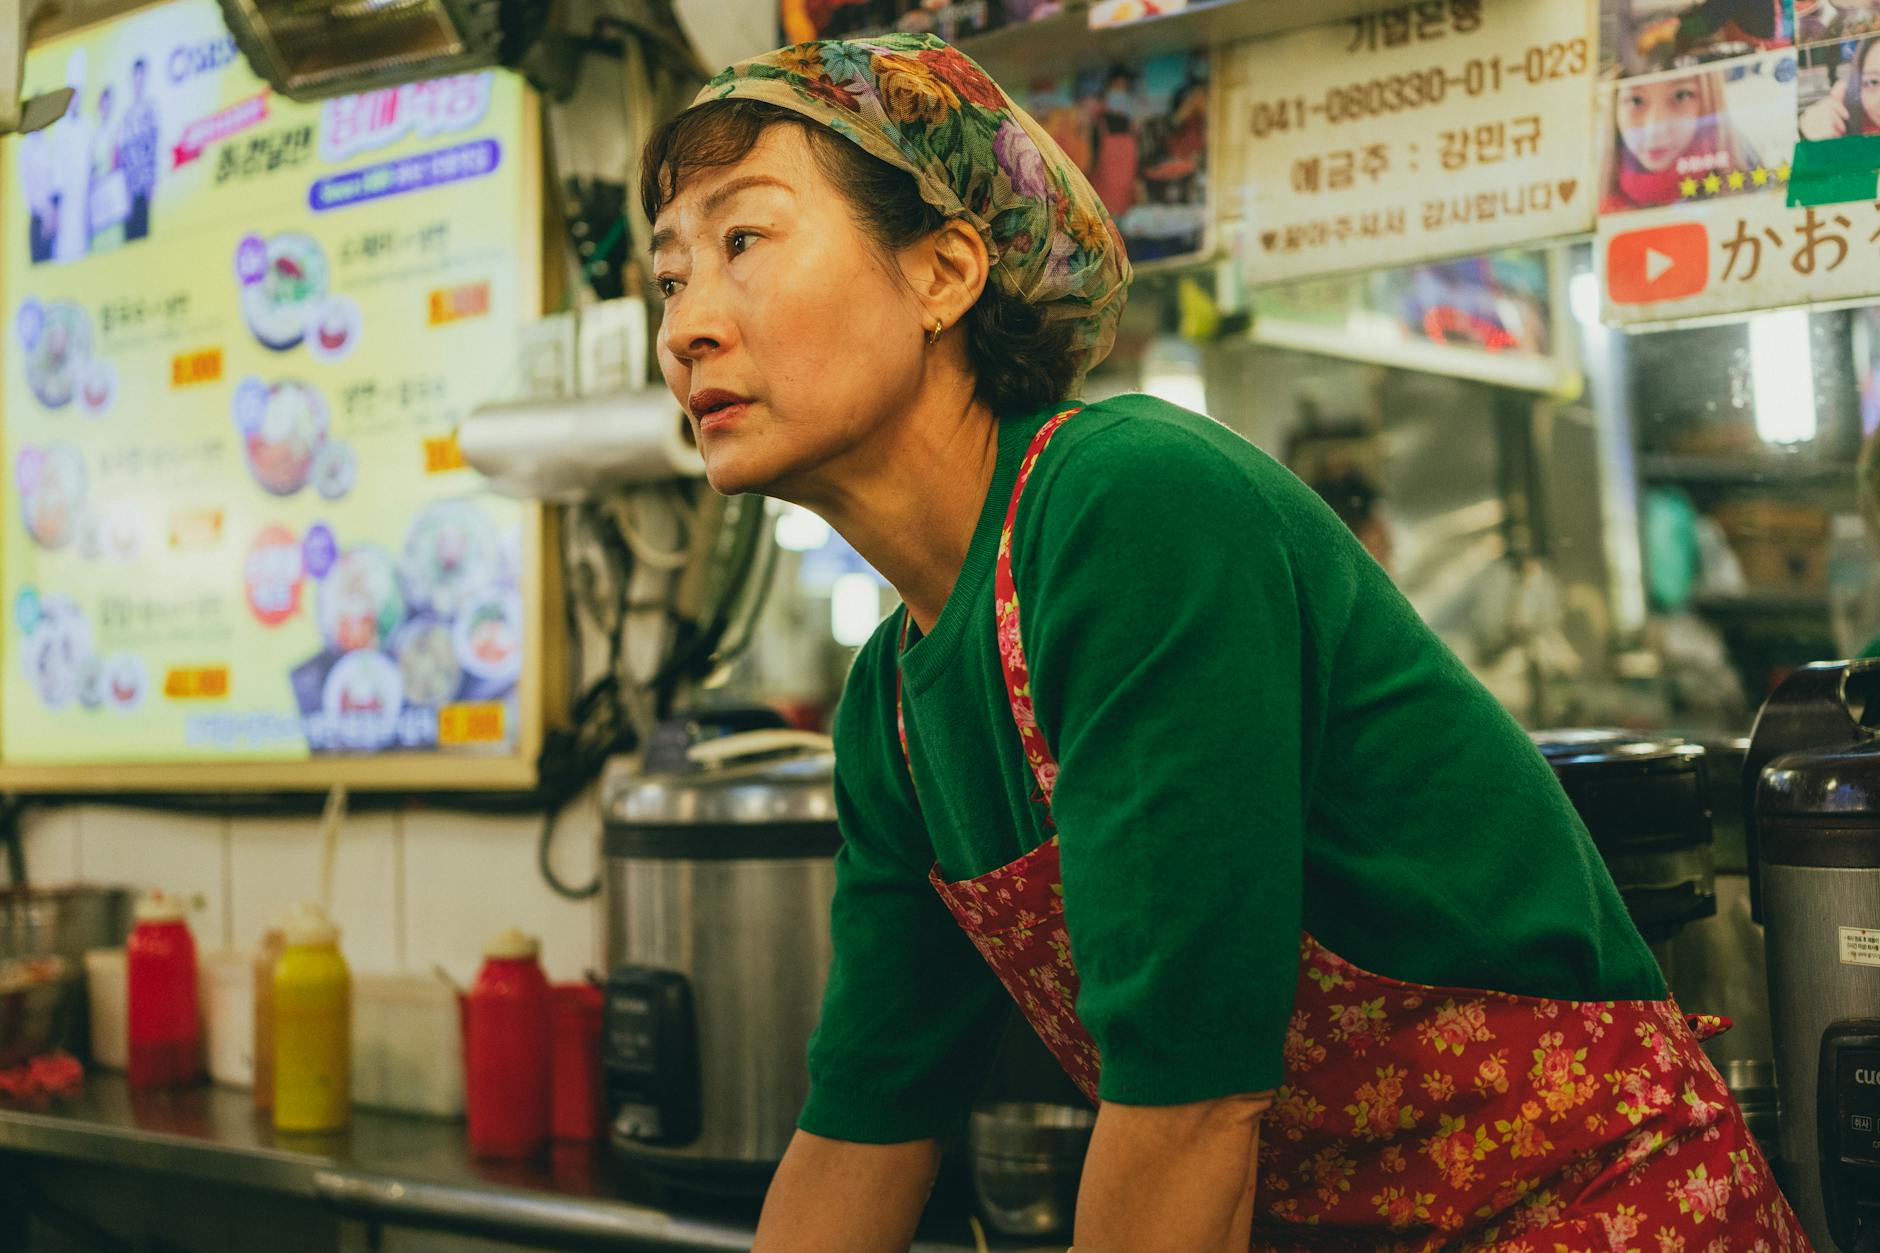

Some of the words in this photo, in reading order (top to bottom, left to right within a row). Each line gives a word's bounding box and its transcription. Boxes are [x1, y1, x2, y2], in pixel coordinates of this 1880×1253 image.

[1291, 143, 1389, 194] 예금주
[1439, 115, 1542, 172] 강민규
[1422, 181, 1552, 232] 감사합니다
[1721, 203, 1880, 283] かお
